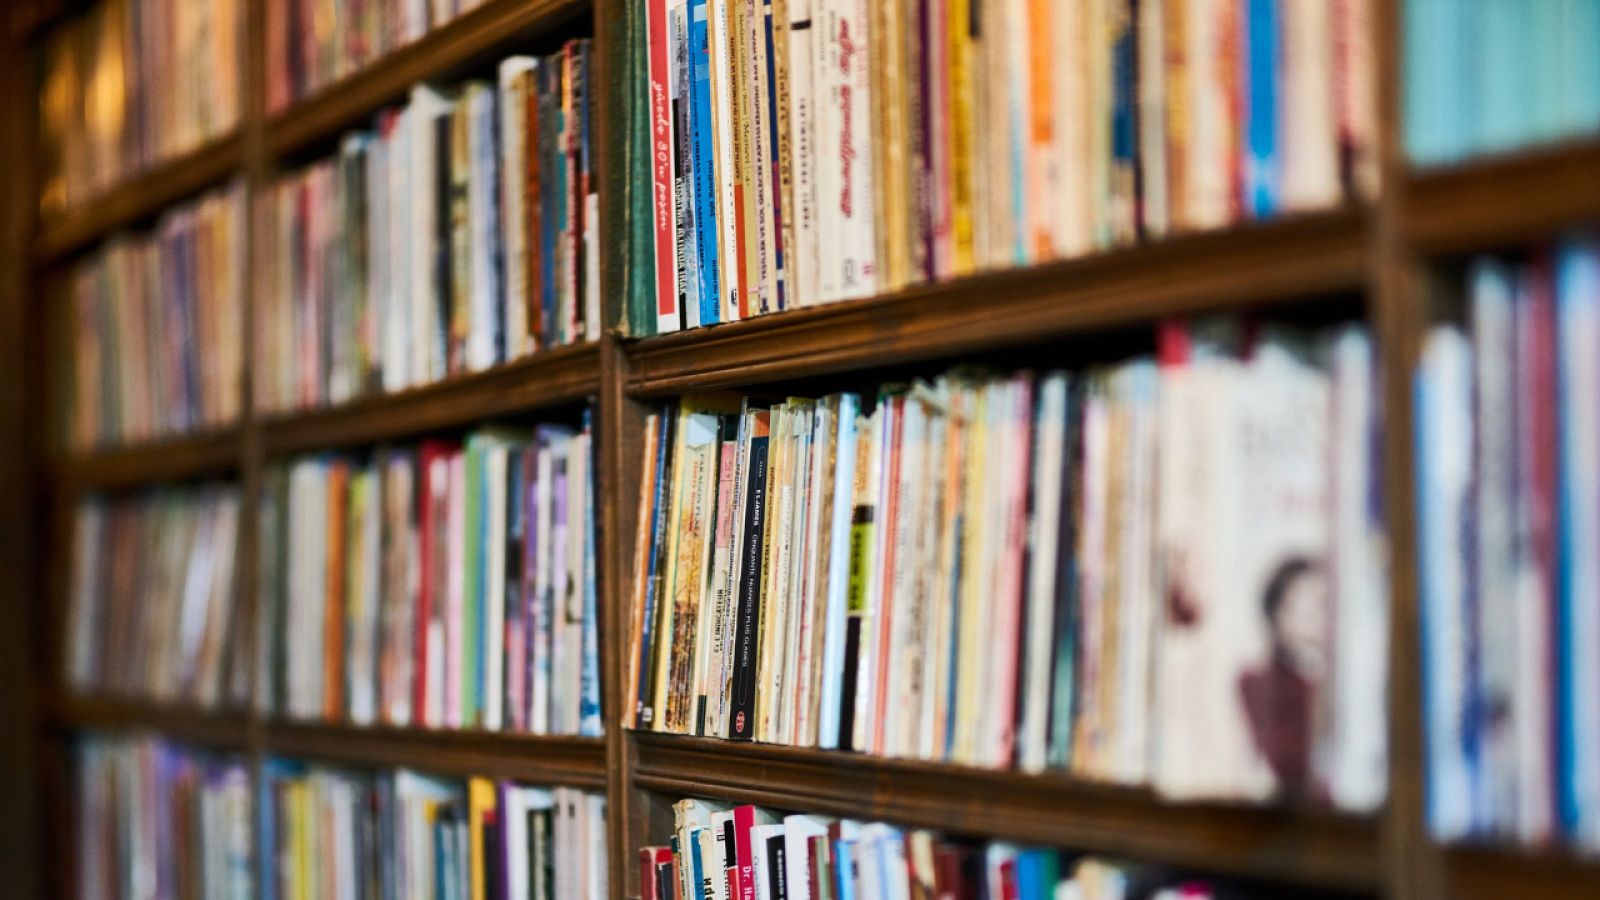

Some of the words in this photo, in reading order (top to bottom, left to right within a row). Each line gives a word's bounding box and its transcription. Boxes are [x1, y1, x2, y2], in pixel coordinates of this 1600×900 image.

[652, 81, 670, 135] yüzde
[656, 182, 668, 231] peşin
[679, 271, 687, 295] IRAK
[752, 499, 760, 526] JAMES
[748, 534, 758, 575] CINQUANTE
[746, 578, 755, 614] NUANCES
[744, 616, 752, 635] PLUS
[743, 865, 752, 882] Dr.
